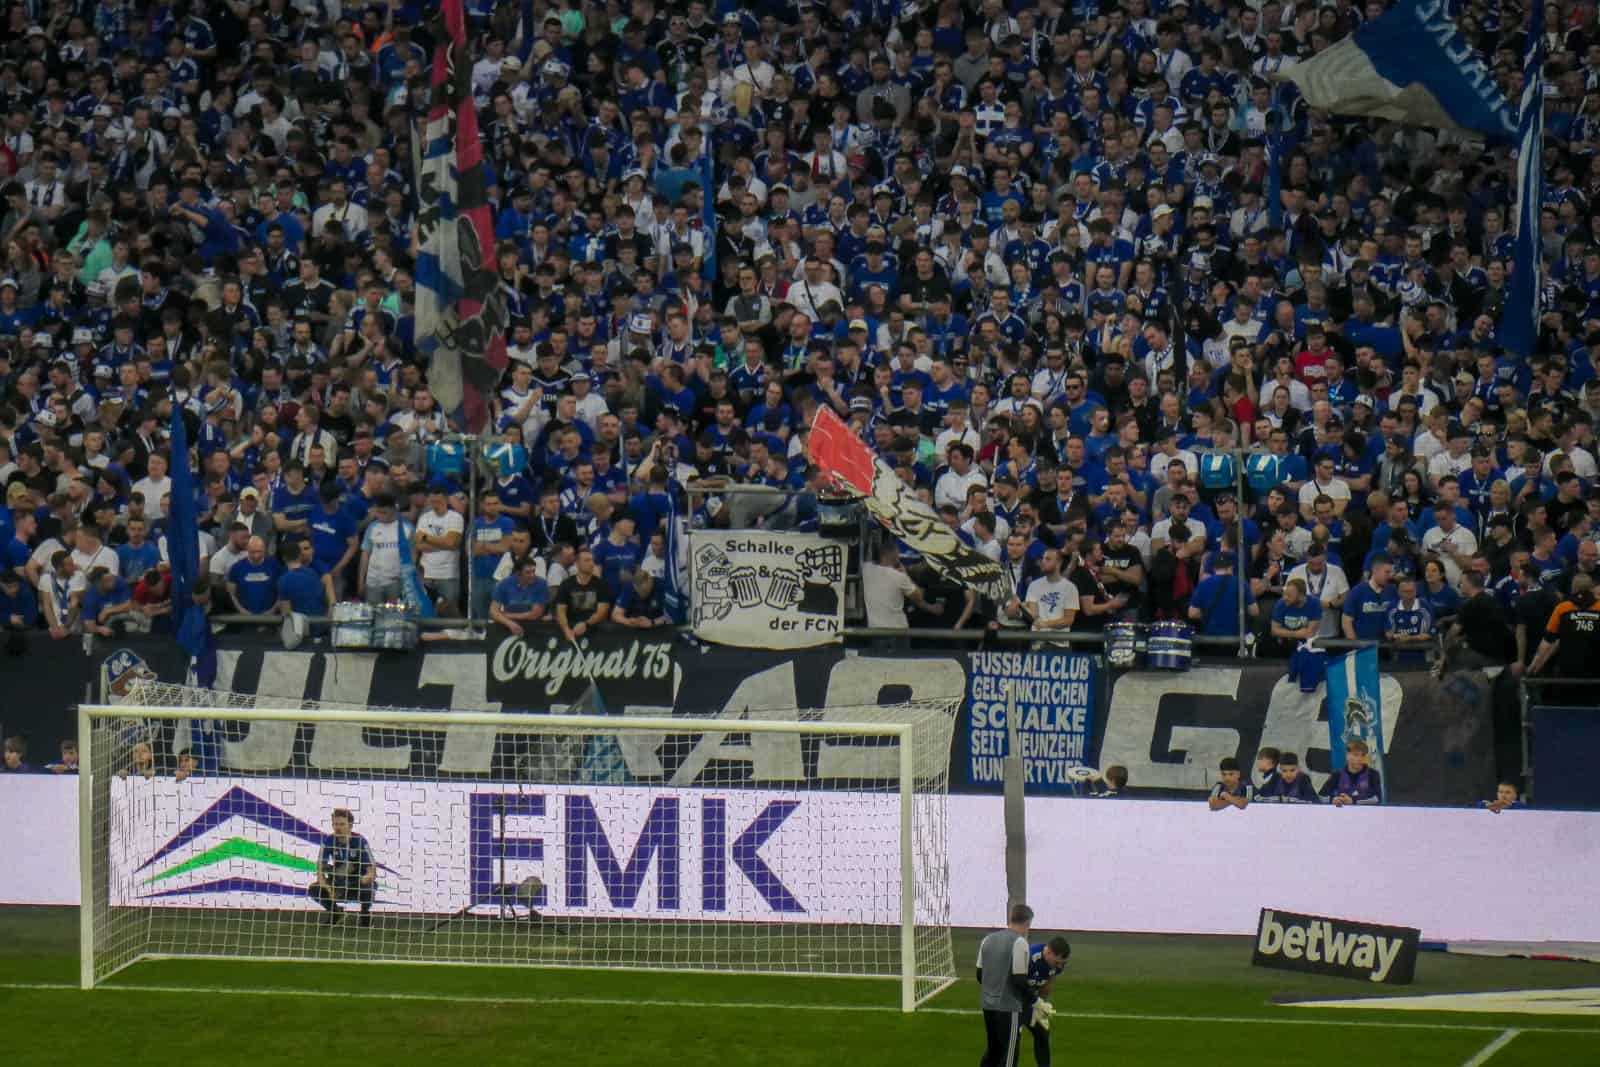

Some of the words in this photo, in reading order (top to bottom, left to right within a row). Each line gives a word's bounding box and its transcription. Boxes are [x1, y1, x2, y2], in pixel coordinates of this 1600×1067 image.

[725, 539, 795, 556] Schalke
[758, 565, 771, 578] &
[769, 617, 798, 631] der
[804, 618, 840, 632] FCN
[492, 634, 638, 697] Original
[642, 642, 671, 679] 75
[969, 651, 1090, 680] FUSSBALLCLUB
[972, 676, 1088, 706] GELSNKIRCHEN
[971, 730, 1005, 755] SEIT
[470, 793, 806, 913] EMK
[1257, 911, 1403, 983] betway
